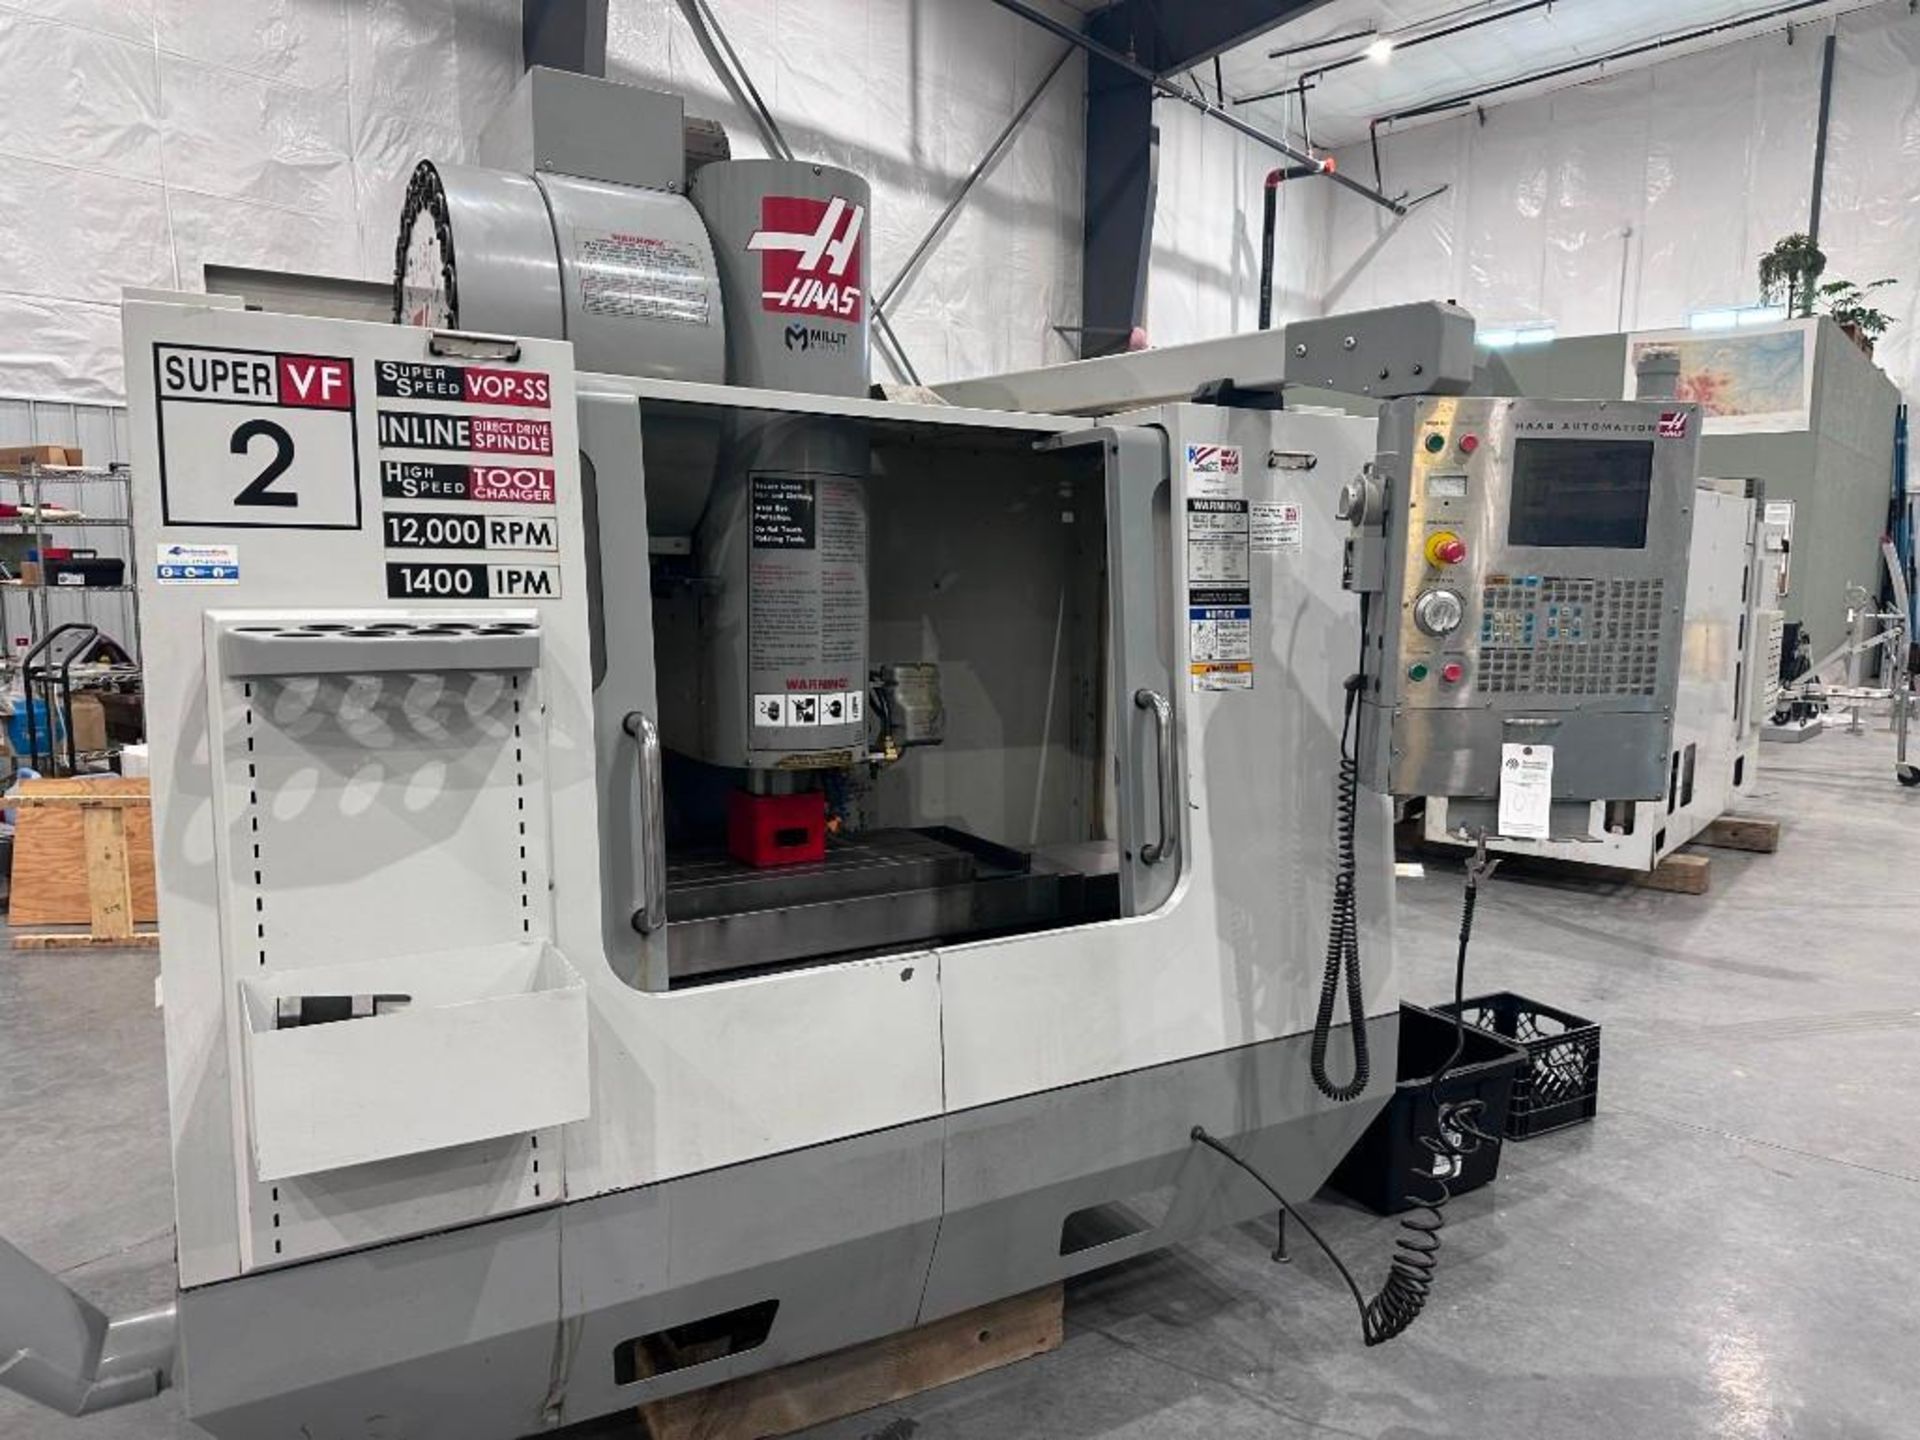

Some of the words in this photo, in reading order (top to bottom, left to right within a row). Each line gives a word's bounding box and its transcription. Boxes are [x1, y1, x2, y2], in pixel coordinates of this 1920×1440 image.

[761, 277, 861, 315] HAAS
[166, 355, 272, 396] SUPER
[287, 363, 342, 400] VF
[381, 362, 446, 381] SUPER
[396, 377, 460, 397] SPEED
[466, 373, 549, 401] VOP-SS
[379, 415, 471, 446] INLINE
[473, 420, 513, 434] DIRECT
[516, 423, 549, 435] DRIVE
[475, 433, 550, 451] SPINDLE
[230, 419, 298, 507] 2
[385, 462, 434, 482] HIGH
[402, 478, 466, 497] SPEED
[473, 468, 551, 489] TOOL
[474, 487, 551, 501] CHANGER
[1192, 500, 1242, 511] WARNING
[388, 518, 481, 546] 12,000
[490, 521, 552, 546] RPM
[400, 568, 473, 594] 1400
[497, 569, 552, 594] IPM
[786, 678, 849, 690] WARNING
